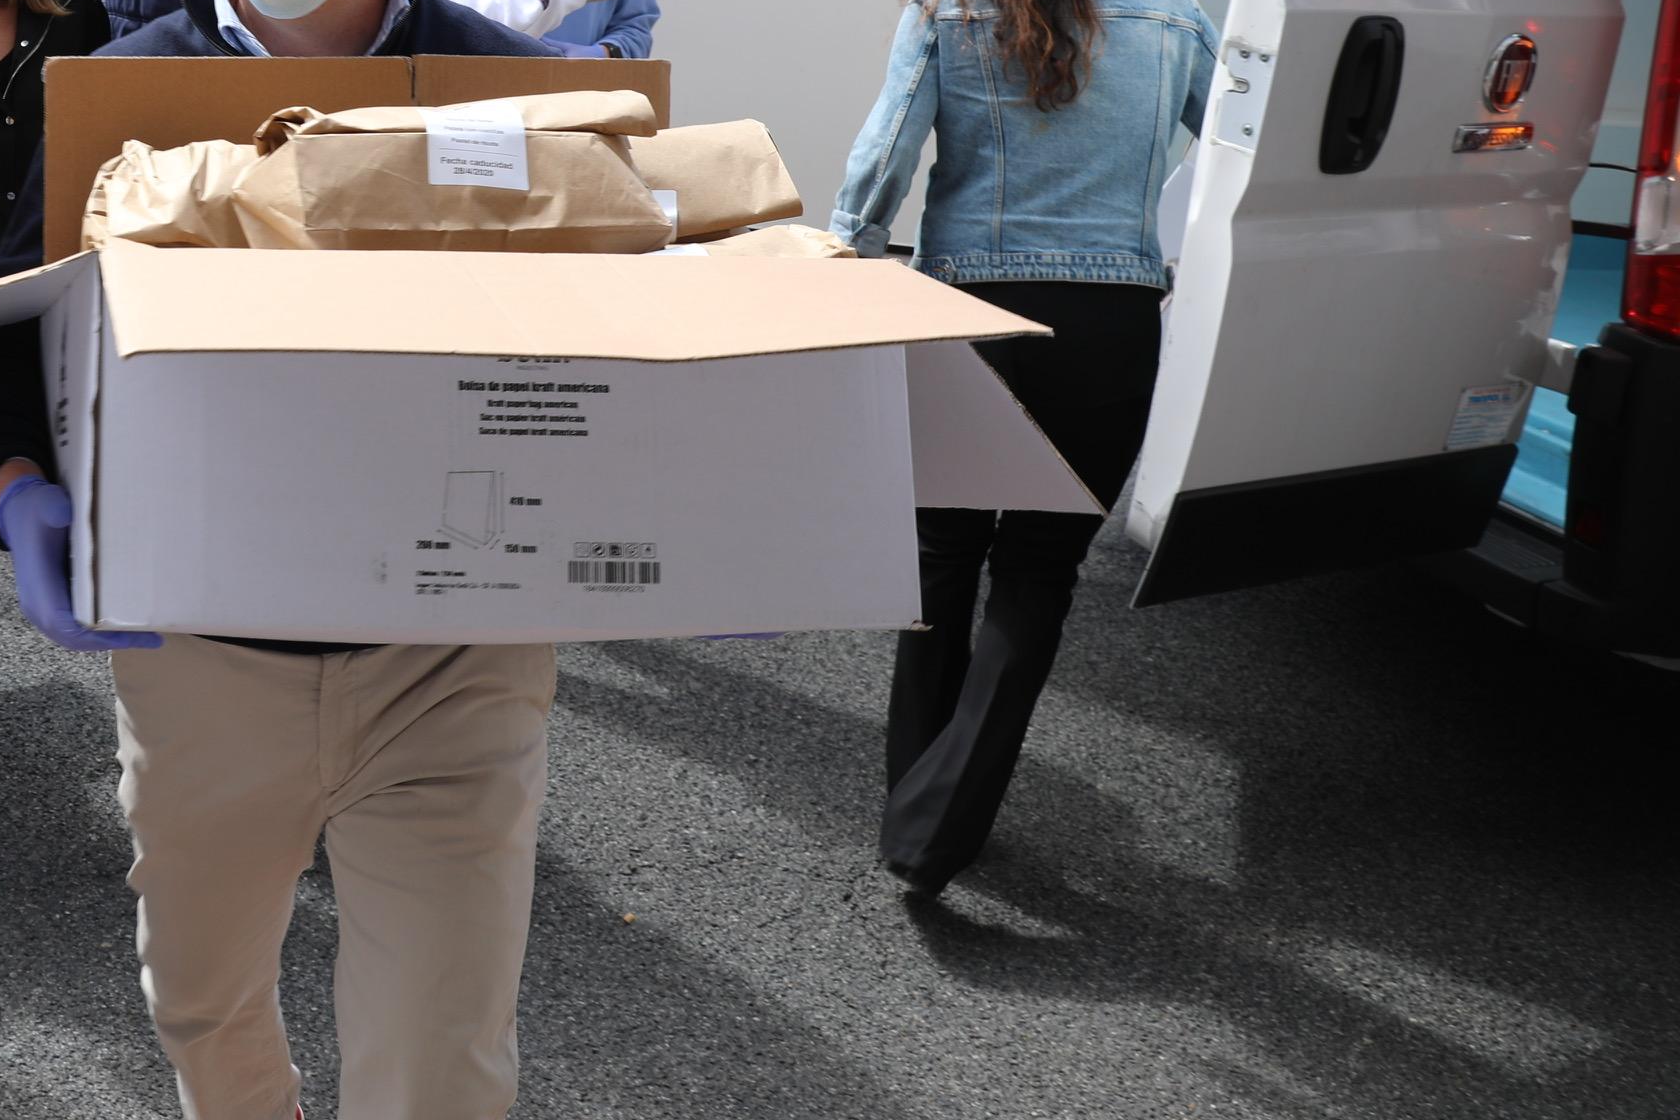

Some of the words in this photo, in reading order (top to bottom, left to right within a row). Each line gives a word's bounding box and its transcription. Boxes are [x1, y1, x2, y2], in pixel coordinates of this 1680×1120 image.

[440, 157, 467, 165] Fecha
[469, 159, 513, 170] caducidad
[458, 380, 486, 391] Bolsa
[488, 381, 500, 391] de
[502, 382, 530, 393] papel
[532, 382, 555, 392] kraft
[557, 383, 610, 393] americana
